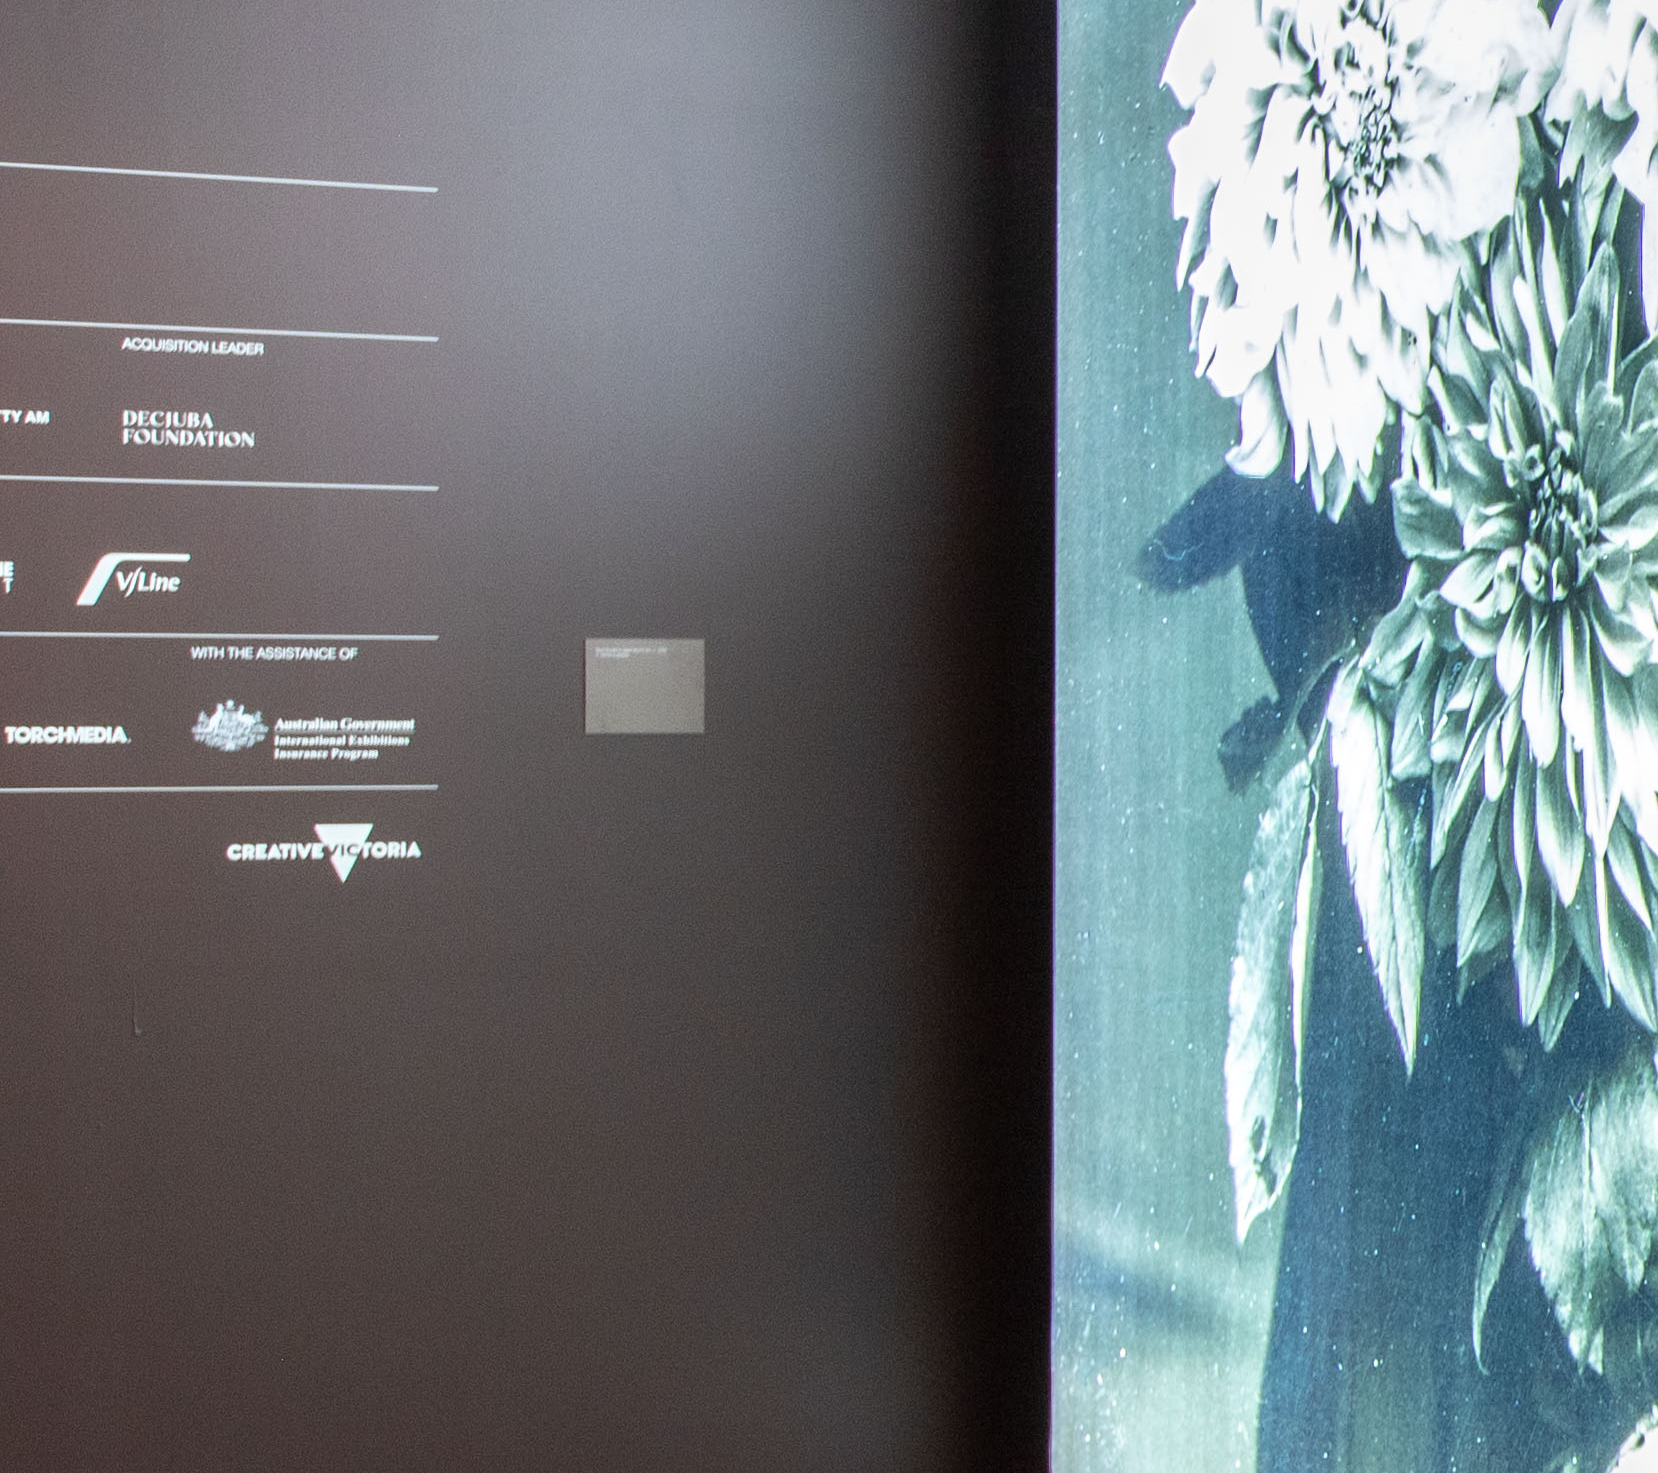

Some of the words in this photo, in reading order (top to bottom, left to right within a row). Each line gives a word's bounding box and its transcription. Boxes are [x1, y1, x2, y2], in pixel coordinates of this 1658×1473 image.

[121, 337, 209, 354] ACQUISITION
[211, 341, 265, 356] LEADER
[0, 409, 22, 424] TY
[24, 410, 50, 425] AM
[122, 410, 214, 429] DECJUBA
[122, 428, 256, 448] FOUNDATION
[116, 566, 182, 598] V/Line
[190, 646, 225, 660] WITH
[228, 646, 254, 660] THE
[256, 647, 337, 661] ASSISTANCE
[339, 647, 359, 661] OF
[274, 717, 339, 732] Australian
[340, 717, 416, 731] Government
[274, 734, 347, 747] International
[348, 734, 411, 747] Exhibitions
[274, 748, 329, 761] Insurance
[331, 748, 379, 762] Program
[226, 842, 325, 862] CREATIVE
[325, 840, 423, 860] VICTORIA
